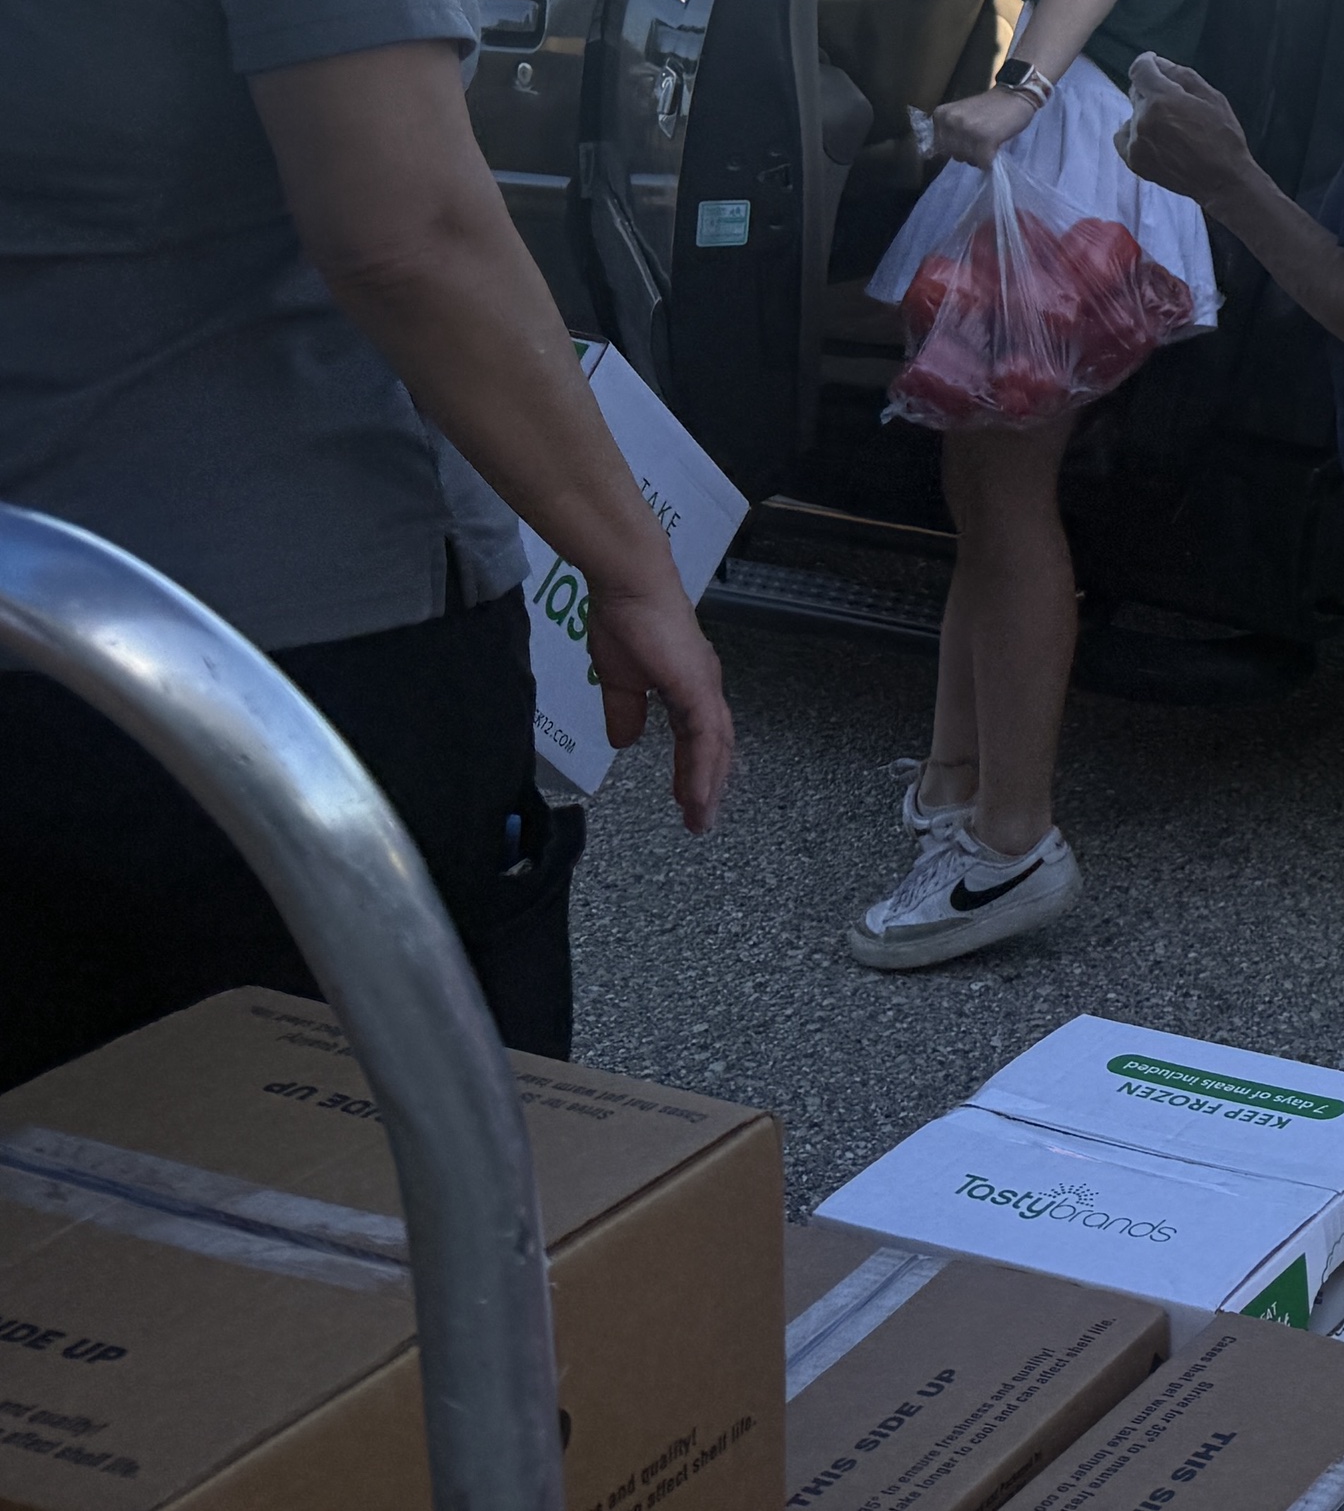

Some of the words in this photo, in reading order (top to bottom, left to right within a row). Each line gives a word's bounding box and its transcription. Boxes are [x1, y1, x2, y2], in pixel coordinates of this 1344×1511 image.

[641, 477, 681, 537] TAKE
[533, 709, 576, 754] K12.COM
[1122, 1060, 1202, 1086] included
[263, 1082, 318, 1101] UP
[1116, 1081, 1222, 1115] FROZEN
[1200, 1078, 1252, 1095] meals
[1249, 1087, 1272, 1101] of
[317, 1092, 382, 1122] IDE
[1273, 1094, 1316, 1110] days
[1315, 1104, 1330, 1114] 7
[1223, 1108, 1293, 1130] KEEP
[0, 1317, 66, 1351] IDE
[62, 1338, 128, 1364] UP
[1200, 1335, 1237, 1362] Cases
[1178, 1363, 1207, 1381] that
[1161, 1382, 1184, 1398] get
[1176, 1381, 1214, 1408] Strive
[915, 1458, 958, 1489] longer
[953, 1446, 972, 1456] to
[970, 1423, 998, 1445] cool
[994, 1403, 1020, 1422] and
[1016, 1385, 1040, 1403] can
[1036, 1357, 1070, 1385] affect
[1066, 1329, 1095, 1358] shelf
[1087, 1318, 1117, 1341] life.
[1130, 1399, 1167, 1425] warm
[1160, 1409, 1184, 1423] for
[881, 1485, 901, 1495] to
[898, 1450, 940, 1483] ensure
[935, 1402, 994, 1449] freshness
[991, 1382, 1016, 1401] and
[1012, 1348, 1056, 1382] quality!
[1145, 1424, 1167, 1443] 35°
[786, 1458, 857, 1507] THIS
[854, 1402, 924, 1452] SIDE
[916, 1368, 956, 1397] UP
[1107, 1426, 1138, 1448] take
[1127, 1443, 1146, 1454] to
[608, 1473, 635, 1510] and
[640, 1426, 697, 1484] quality!
[647, 1463, 689, 1509] affect
[692, 1430, 727, 1474] shelf
[731, 1415, 758, 1443] life.
[1070, 1449, 1114, 1481] longer
[1170, 1432, 1237, 1482] THIS
[1088, 1455, 1131, 1489] ensure
[1057, 1482, 1077, 1493] to
[1133, 1488, 1175, 1511] SI
